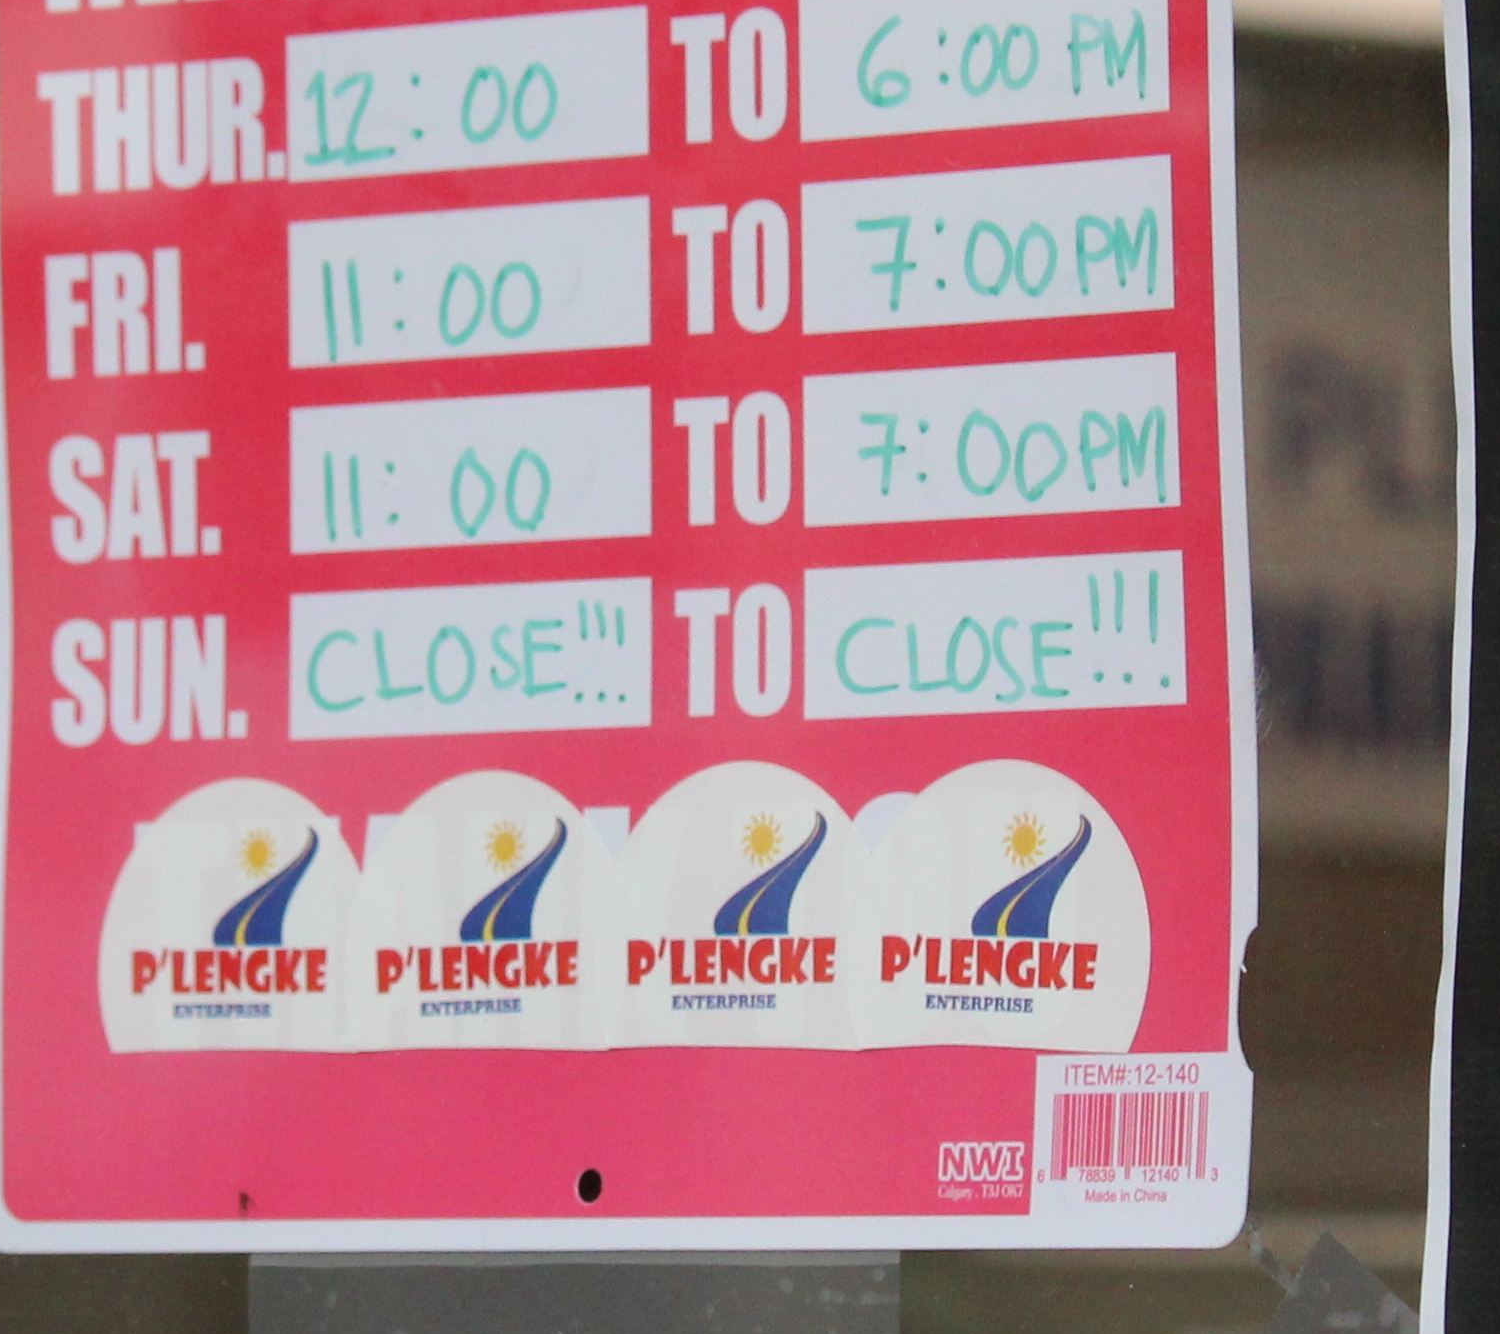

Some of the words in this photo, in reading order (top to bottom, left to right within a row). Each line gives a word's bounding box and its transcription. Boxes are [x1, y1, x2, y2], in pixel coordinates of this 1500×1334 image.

[35, 58, 285, 197] THUR.
[303, 62, 560, 167] 12:00
[670, 7, 788, 144] TO
[45, 247, 205, 380] FRI.
[321, 259, 544, 362] 11:00
[672, 199, 790, 335] TO
[48, 431, 221, 565] SAT.
[324, 447, 553, 542] 11:00
[674, 391, 791, 526] TO
[51, 615, 249, 748] SUN.
[674, 583, 793, 718] TO
[134, 949, 326, 992] P'LENGKE
[378, 941, 577, 992] P'LENGKE
[629, 938, 835, 984] P'LENGKE
[882, 936, 1097, 989] P'LENGKE
[174, 1004, 274, 1020] ENTERPRISE
[421, 999, 523, 1018] ENTERPRISE
[671, 995, 778, 1011] ENTERPRISE
[925, 994, 1035, 1015] ENTERPRISE
[938, 1141, 1025, 1182] NWI
[1037, 1170, 1045, 1183] 6
[1078, 1170, 1116, 1182] 78839
[1142, 1169, 1179, 1182] 12140
[1211, 1168, 1219, 1181] 3
[1084, 1189, 1117, 1202] Made
[1120, 1189, 1130, 1201] in
[1134, 1189, 1167, 1202] China
